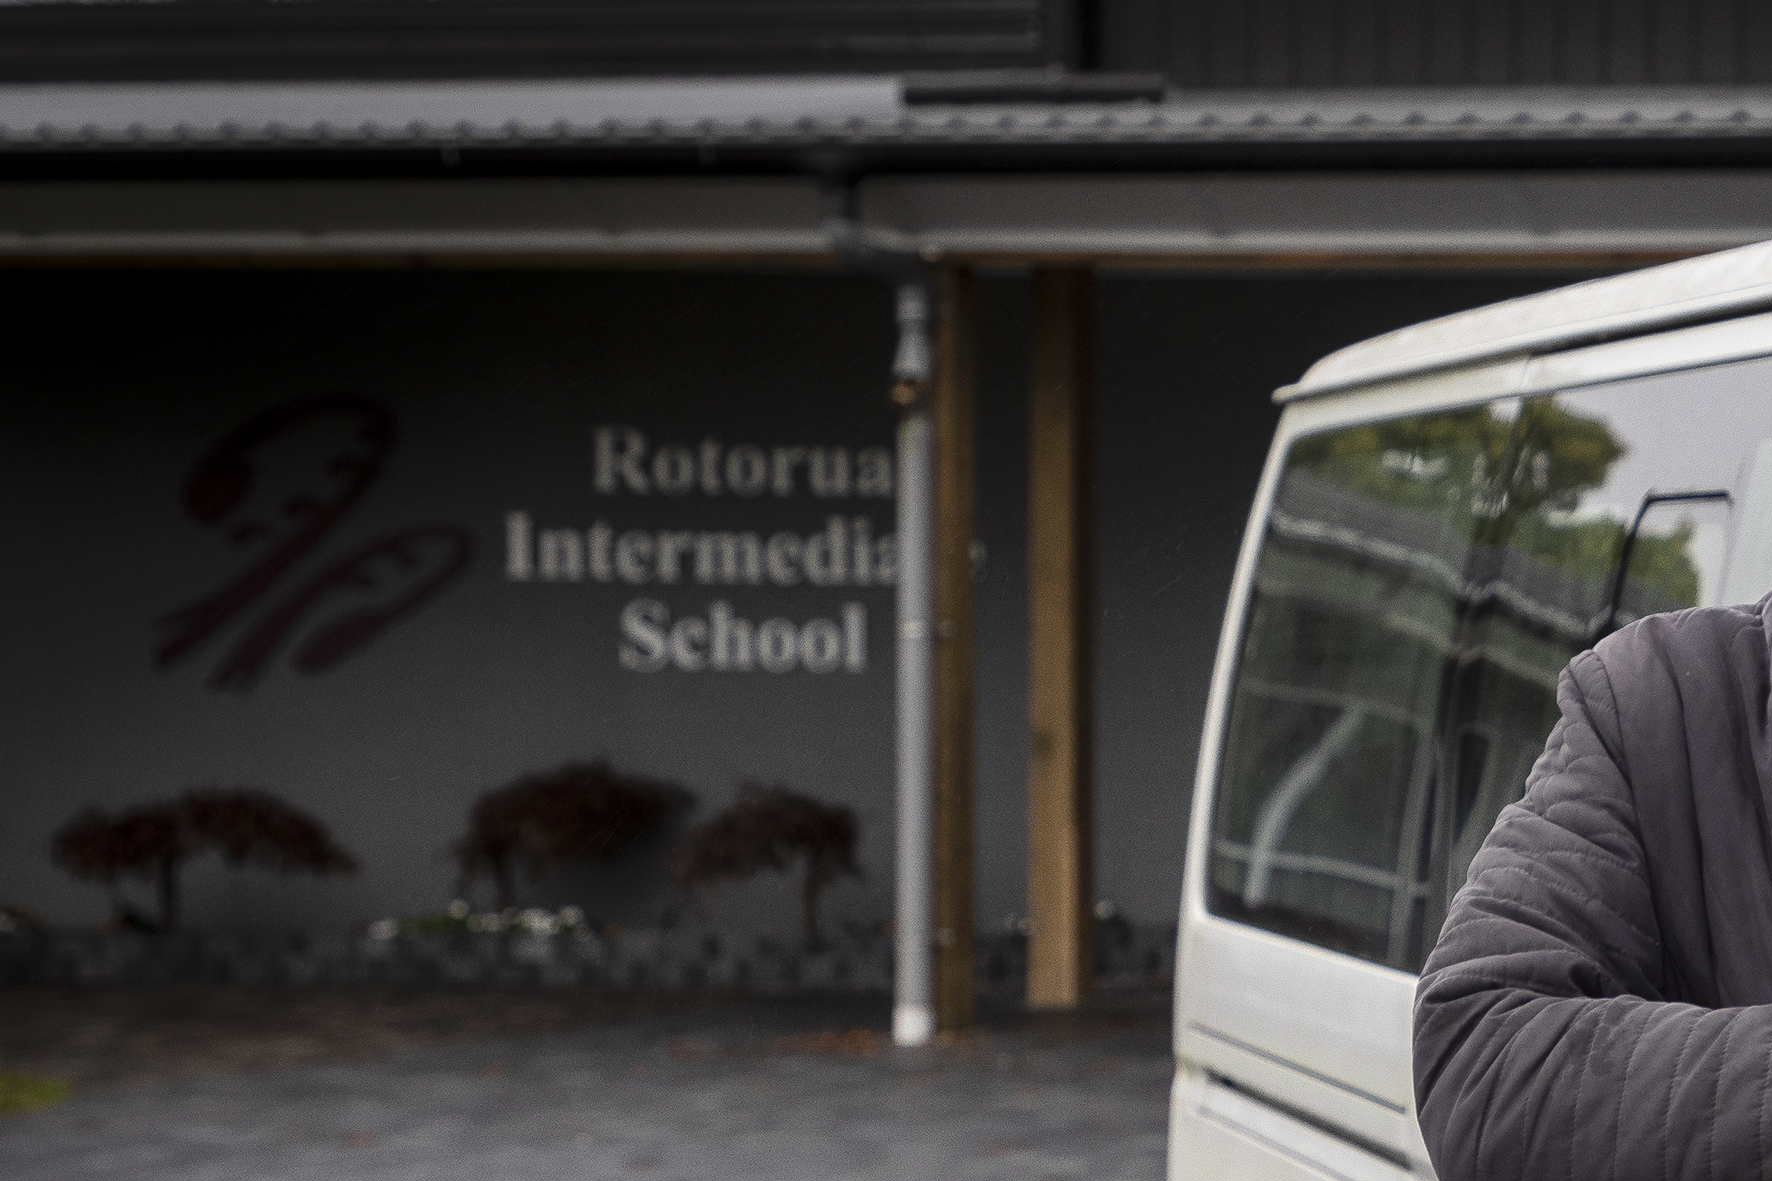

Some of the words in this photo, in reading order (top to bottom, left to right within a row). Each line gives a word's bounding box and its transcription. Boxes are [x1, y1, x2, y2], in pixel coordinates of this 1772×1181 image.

[595, 426, 894, 497] Rotorua
[506, 510, 898, 585] Intermedia
[618, 599, 868, 674] School
